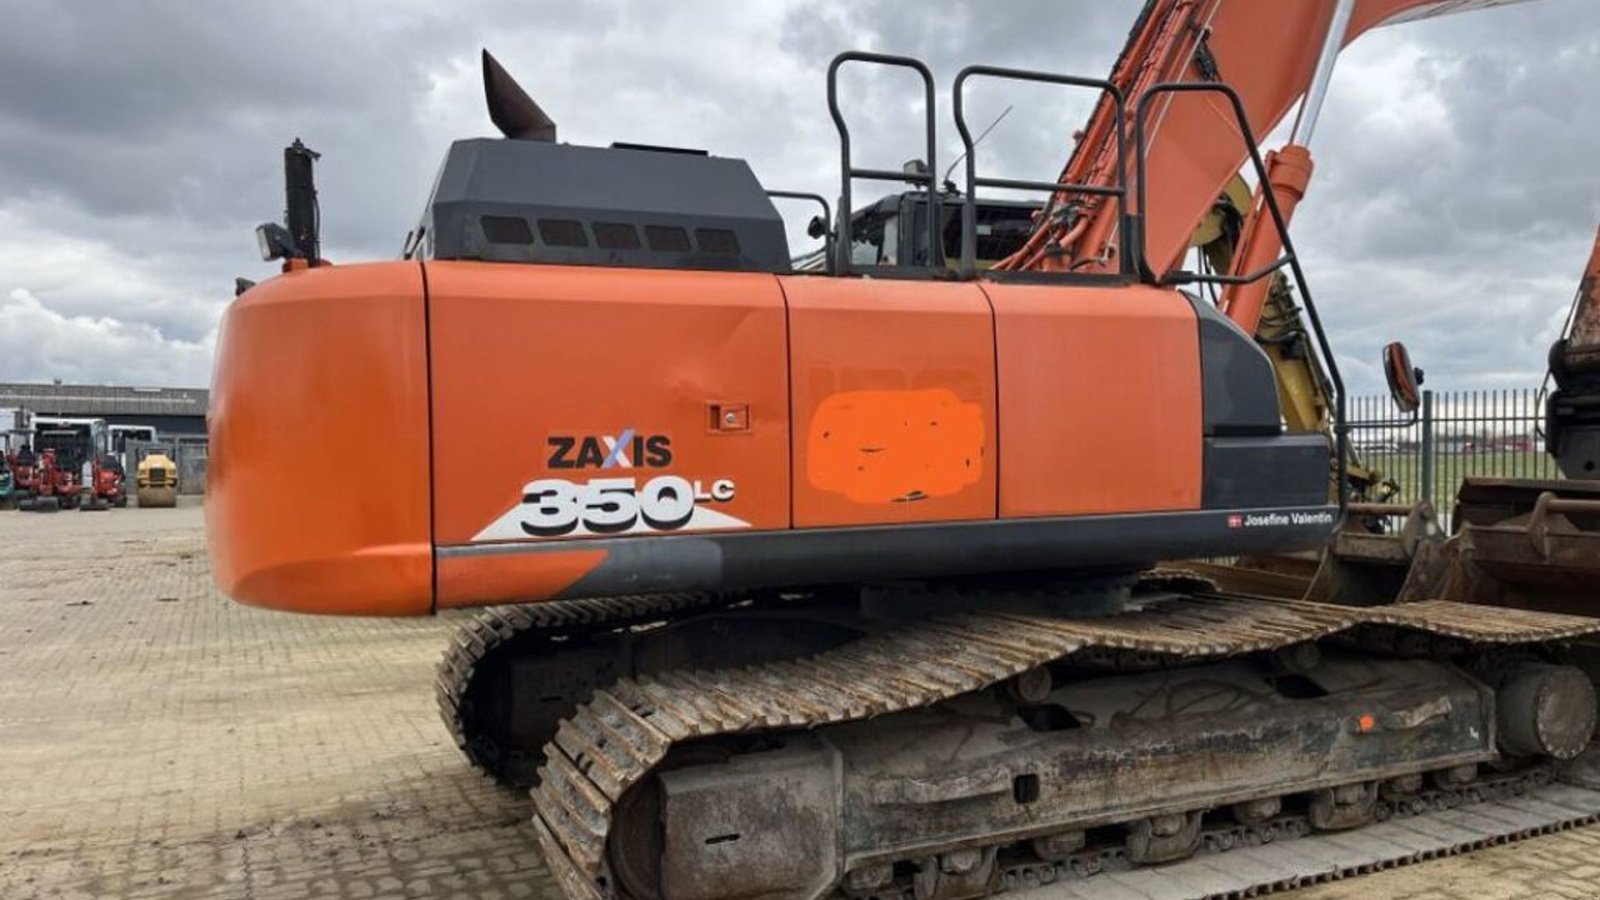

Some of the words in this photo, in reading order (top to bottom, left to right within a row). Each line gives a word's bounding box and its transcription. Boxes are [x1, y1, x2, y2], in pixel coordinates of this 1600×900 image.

[547, 428, 671, 469] ZAXIS
[1245, 514, 1289, 526] Josefine
[1292, 512, 1332, 525] Valentin
